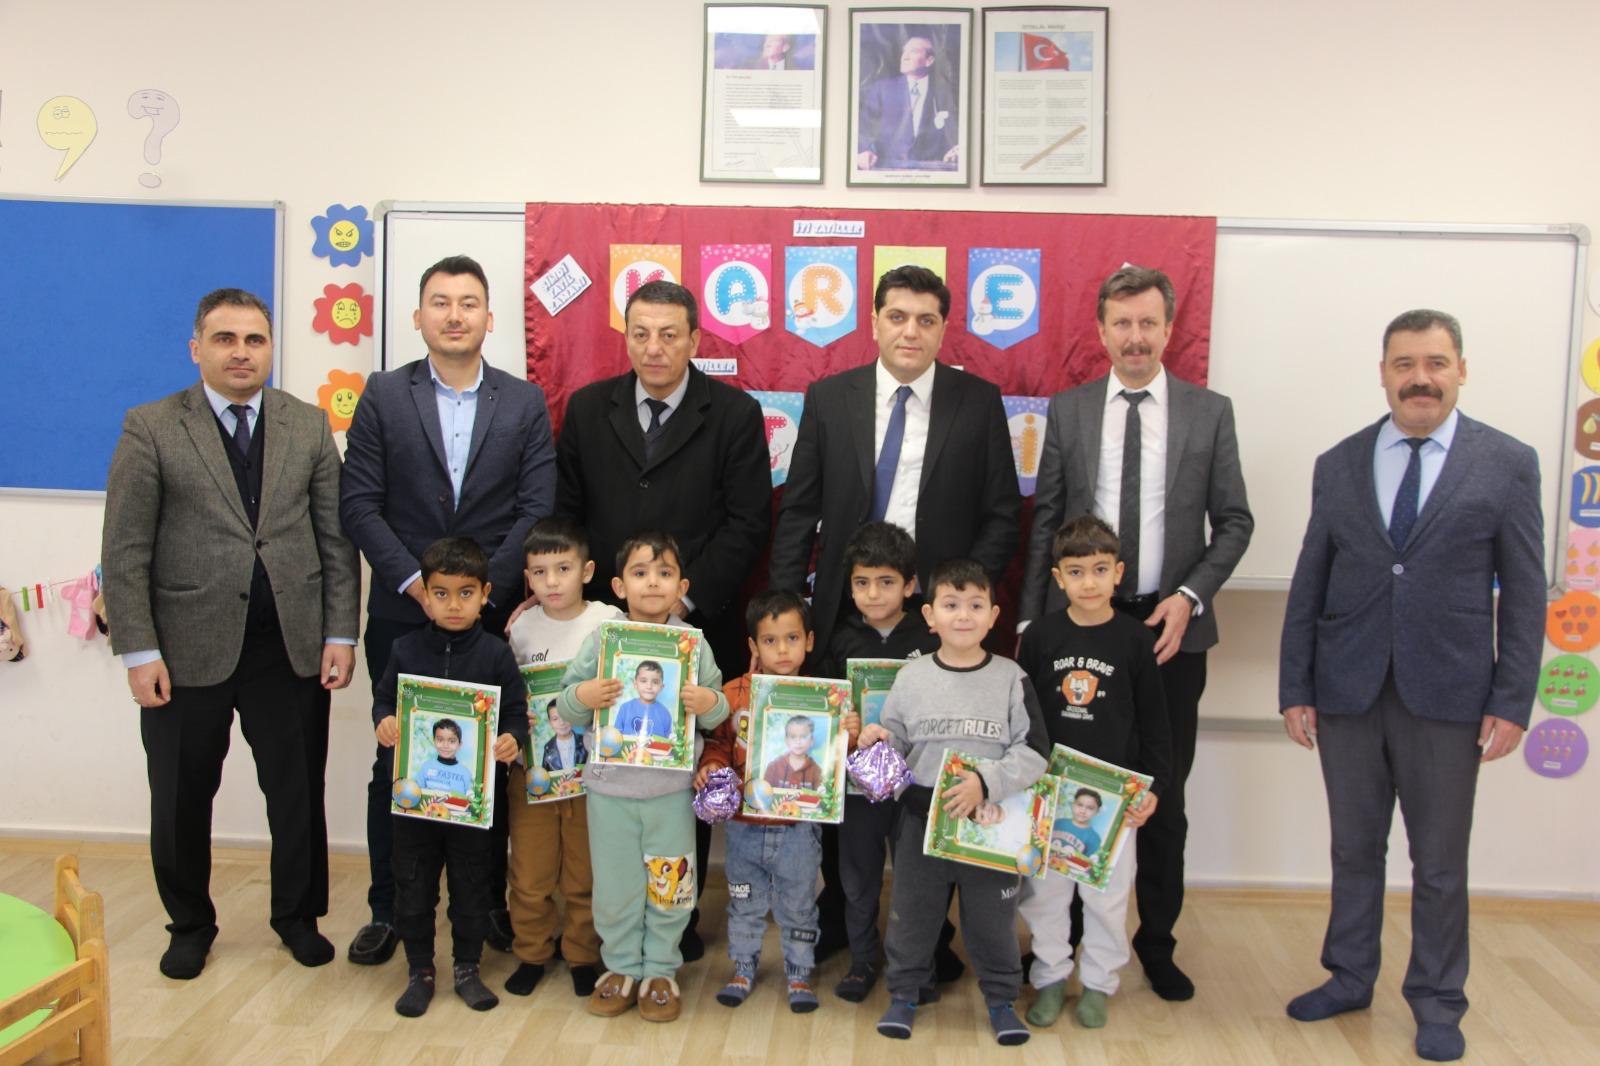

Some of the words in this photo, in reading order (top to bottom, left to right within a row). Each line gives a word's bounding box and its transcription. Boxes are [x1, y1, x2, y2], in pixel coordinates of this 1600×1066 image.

[1054, 656, 1075, 671] ROAR
[1086, 658, 1115, 676] BRAVE
[919, 719, 963, 736] FORGET
[963, 719, 1002, 739] RULES
